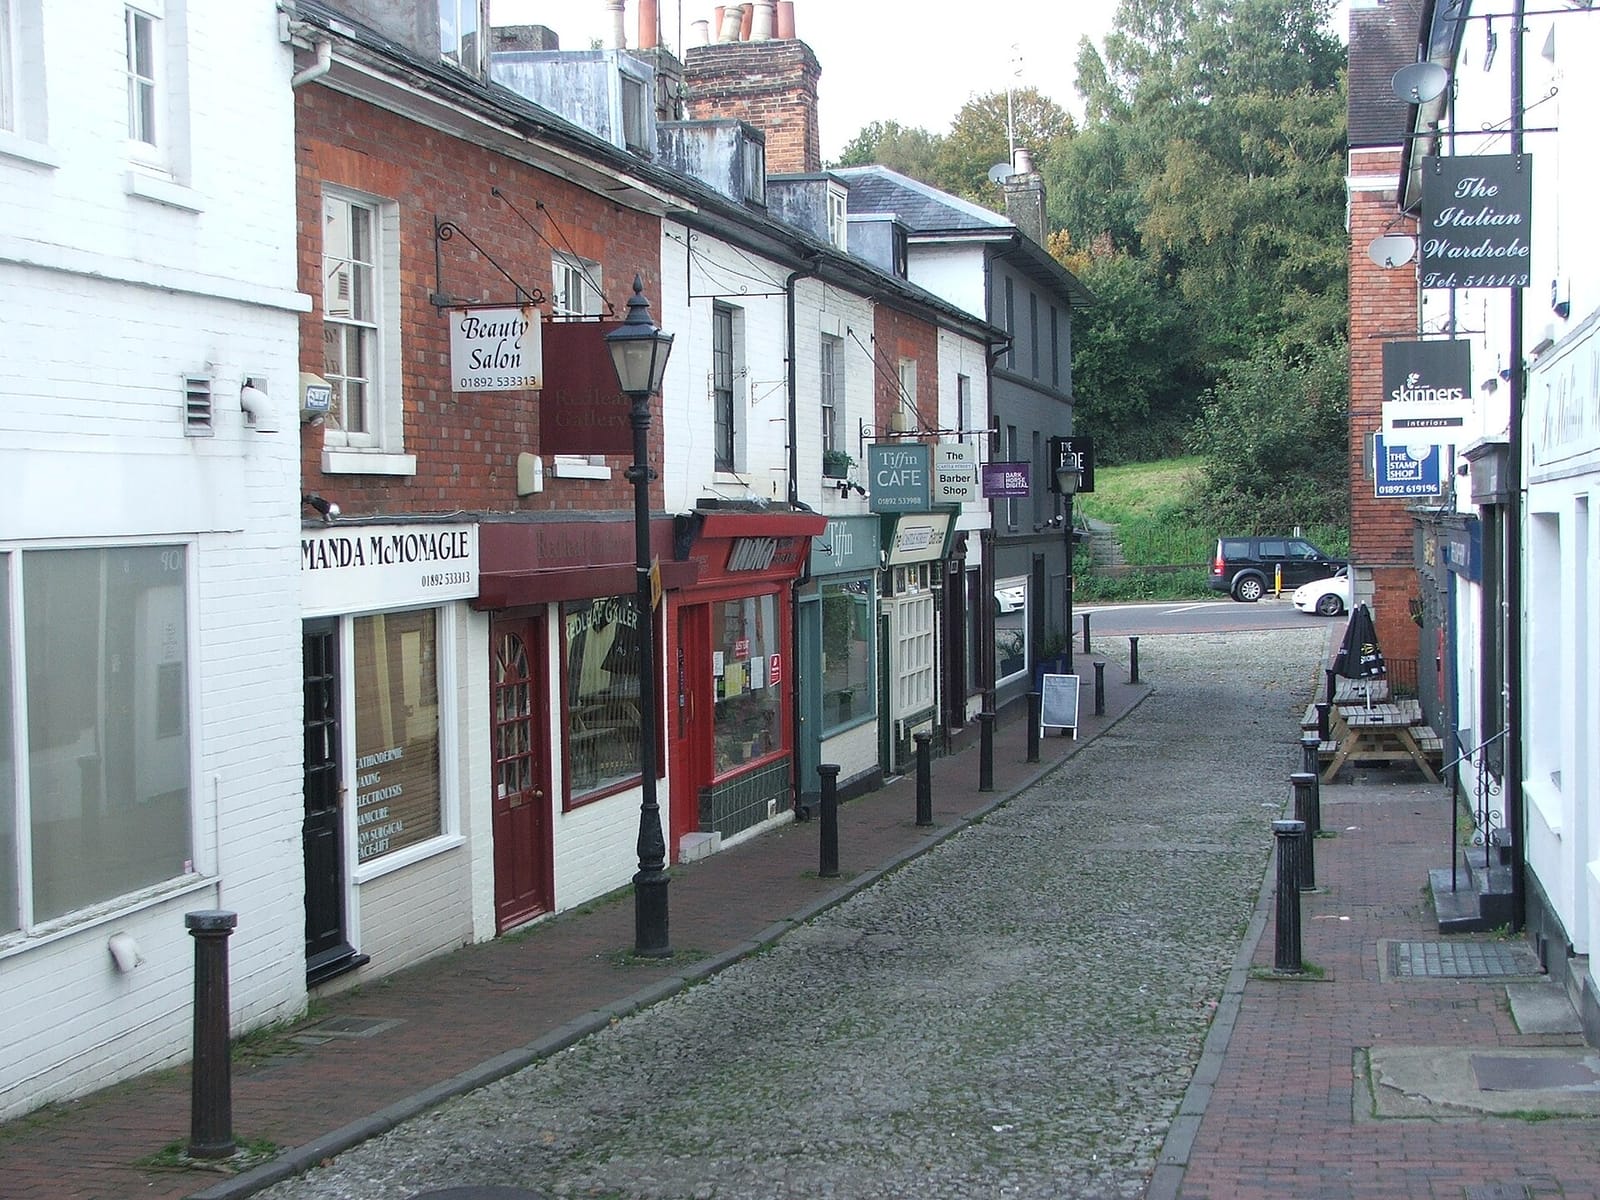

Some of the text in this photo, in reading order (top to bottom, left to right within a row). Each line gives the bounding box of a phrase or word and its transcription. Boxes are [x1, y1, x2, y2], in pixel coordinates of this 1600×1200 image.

[1455, 177, 1498, 198] The
[1433, 207, 1521, 227] Italian
[1423, 238, 1529, 258] Wardrobe
[1423, 273, 1528, 287] Tel: 514143
[461, 317, 528, 349] Beauty
[469, 338, 522, 369] Salon
[460, 376, 536, 387] 01892 533313
[1391, 385, 1463, 401] skinners
[1407, 419, 1448, 427] interiors
[880, 451, 918, 469] Tiffin
[946, 452, 964, 460] The
[1390, 453, 1406, 461] THE
[1390, 461, 1418, 470] STAMP
[877, 470, 921, 487] CAFE
[940, 474, 970, 482] Barber
[1390, 470, 1414, 478] SHOP
[943, 486, 968, 496] Shop
[1379, 484, 1437, 494] 01892 619196
[301, 531, 469, 570] MANDA McMONAGLE
[727, 537, 777, 571] INDIGO
[422, 571, 470, 587] 01892 533313
[357, 783, 403, 807] LECTROLYSIS
[358, 838, 390, 859] ACE-LIFT
